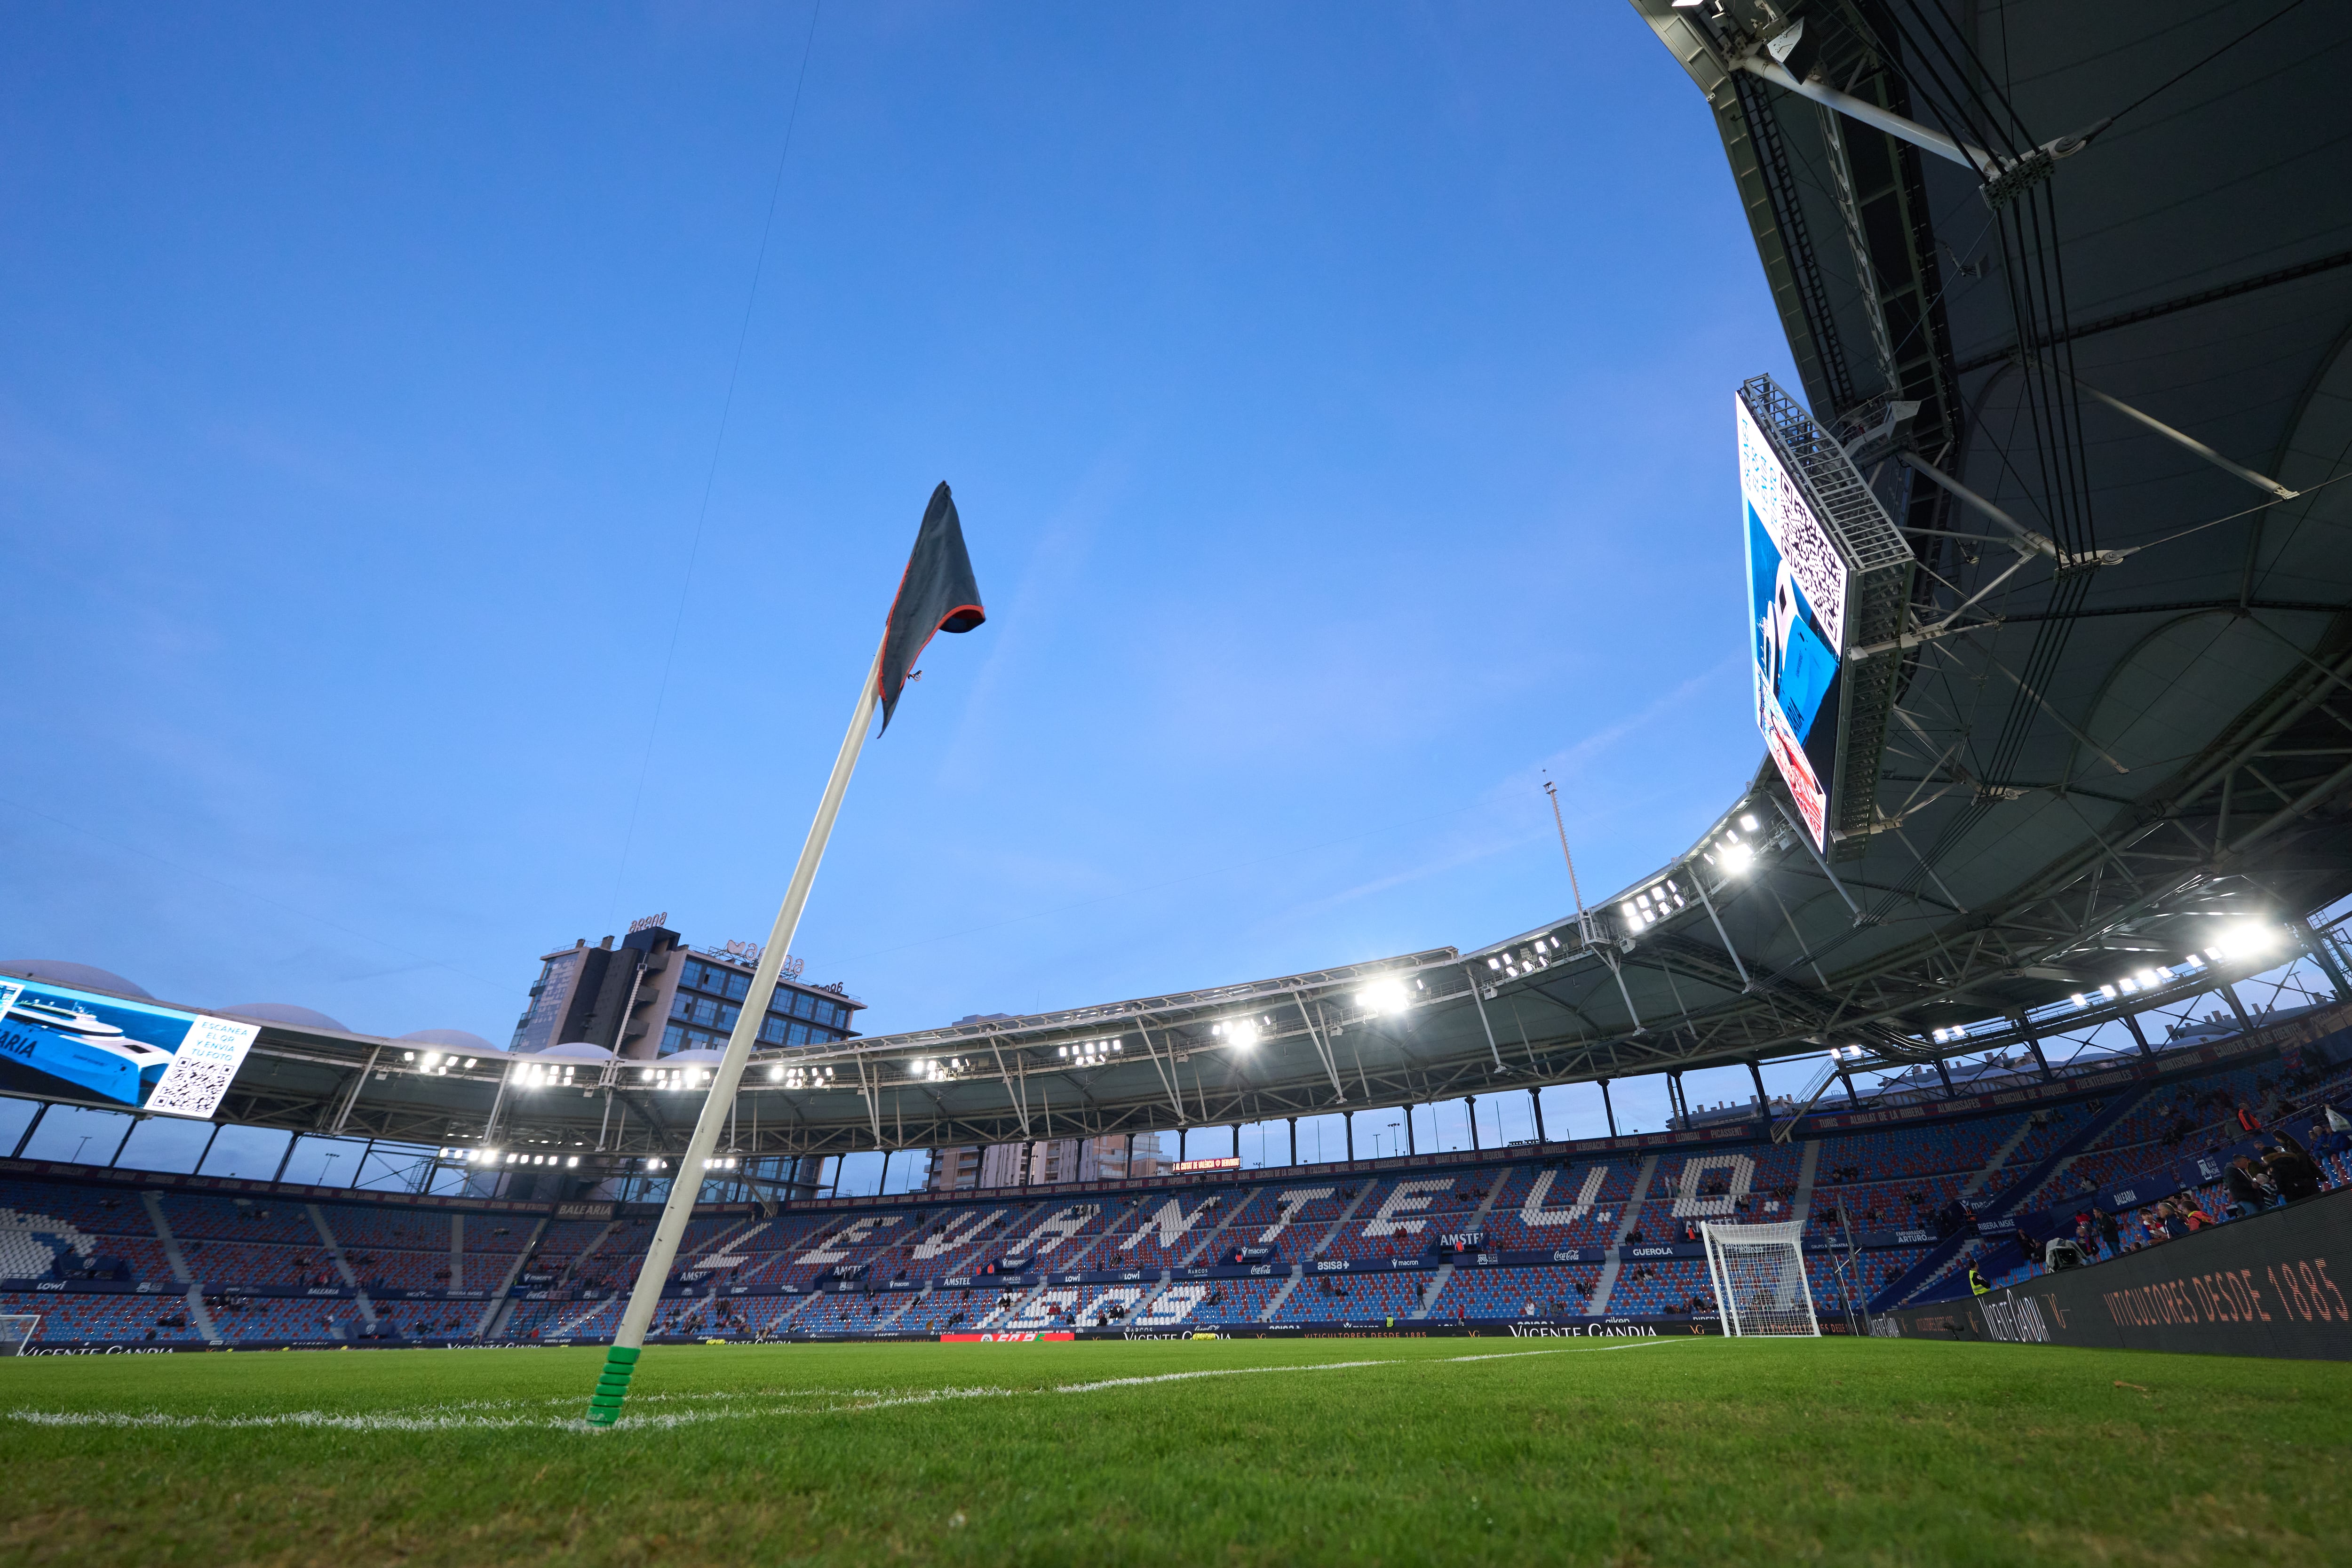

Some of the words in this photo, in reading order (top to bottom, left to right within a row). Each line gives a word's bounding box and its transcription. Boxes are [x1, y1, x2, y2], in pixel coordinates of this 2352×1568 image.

[628, 911, 667, 934] arena
[746, 943, 805, 976] ana
[201, 1022, 248, 1036] ESCANEA
[2214, 1038, 2247, 1058] CAUDETE
[2247, 1036, 2258, 1049] DE
[2259, 1031, 2273, 1044] LAS
[206, 1051, 232, 1061] FOTO
[2156, 1051, 2202, 1073] MONTSERRAT
[2075, 1069, 2133, 1090] FUENTERROBLES
[1993, 1090, 2026, 1105] BENICULL
[2027, 1089, 2036, 1099] DE
[1938, 1098, 1981, 1114] ALMUSSAFES
[1850, 1114, 1876, 1125] ALBALAT
[1880, 1112, 1887, 1122] DE
[1889, 1110, 1899, 1120] LA
[1900, 1106, 1925, 1118] RIBERA
[1819, 1117, 1838, 1128] TURÍS
[1675, 1132, 1700, 1142] LLOMBAI
[1710, 1127, 1743, 1138] PICASSENT
[1647, 1135, 1668, 1145] CARLET
[1542, 1145, 1567, 1154] XIRIVELLA
[1576, 1141, 1606, 1152] ALBORACHE
[1482, 1151, 1505, 1161] REQUENA
[1512, 1148, 1534, 1157] TORRENT
[1375, 1159, 1405, 1169] GUADASSUAR
[1409, 1157, 1429, 1166] MISLATA
[1435, 1155, 1450, 1165] QUART
[1452, 1154, 1458, 1162] DE
[1459, 1153, 1476, 1162] POBLET
[1288, 1167, 1305, 1176] CORONA
[1335, 1163, 1349, 1172] BUÑOL
[1354, 1162, 1370, 1171] CHESTE
[1126, 1179, 1143, 1188] PICANYA
[1167, 1177, 1186, 1185] PAIPORTA
[2114, 1189, 2137, 1206] BALEARIA
[557, 1203, 612, 1216] BALEARIA
[1978, 1222, 1999, 1231] RIBERA
[1998, 1219, 2015, 1228] IMSKE
[1554, 1250, 1579, 1261] Coca-Cola
[1632, 1248, 1672, 1257] GUEROLA
[1318, 1261, 1343, 1270] asisa
[944, 1277, 970, 1286] AMSTEL
[2103, 1278, 2198, 1327] VITICULTORES
[2191, 1269, 2272, 1322] DESDE
[2267, 1258, 2349, 1321] 1885
[1978, 1297, 2019, 1341] VICENTE
[2007, 1289, 2051, 1342] GANDIA
[1508, 1324, 1581, 1337] VICENTE
[1588, 1323, 1657, 1337] GANDIA
[1123, 1332, 1177, 1340] VICENTE
